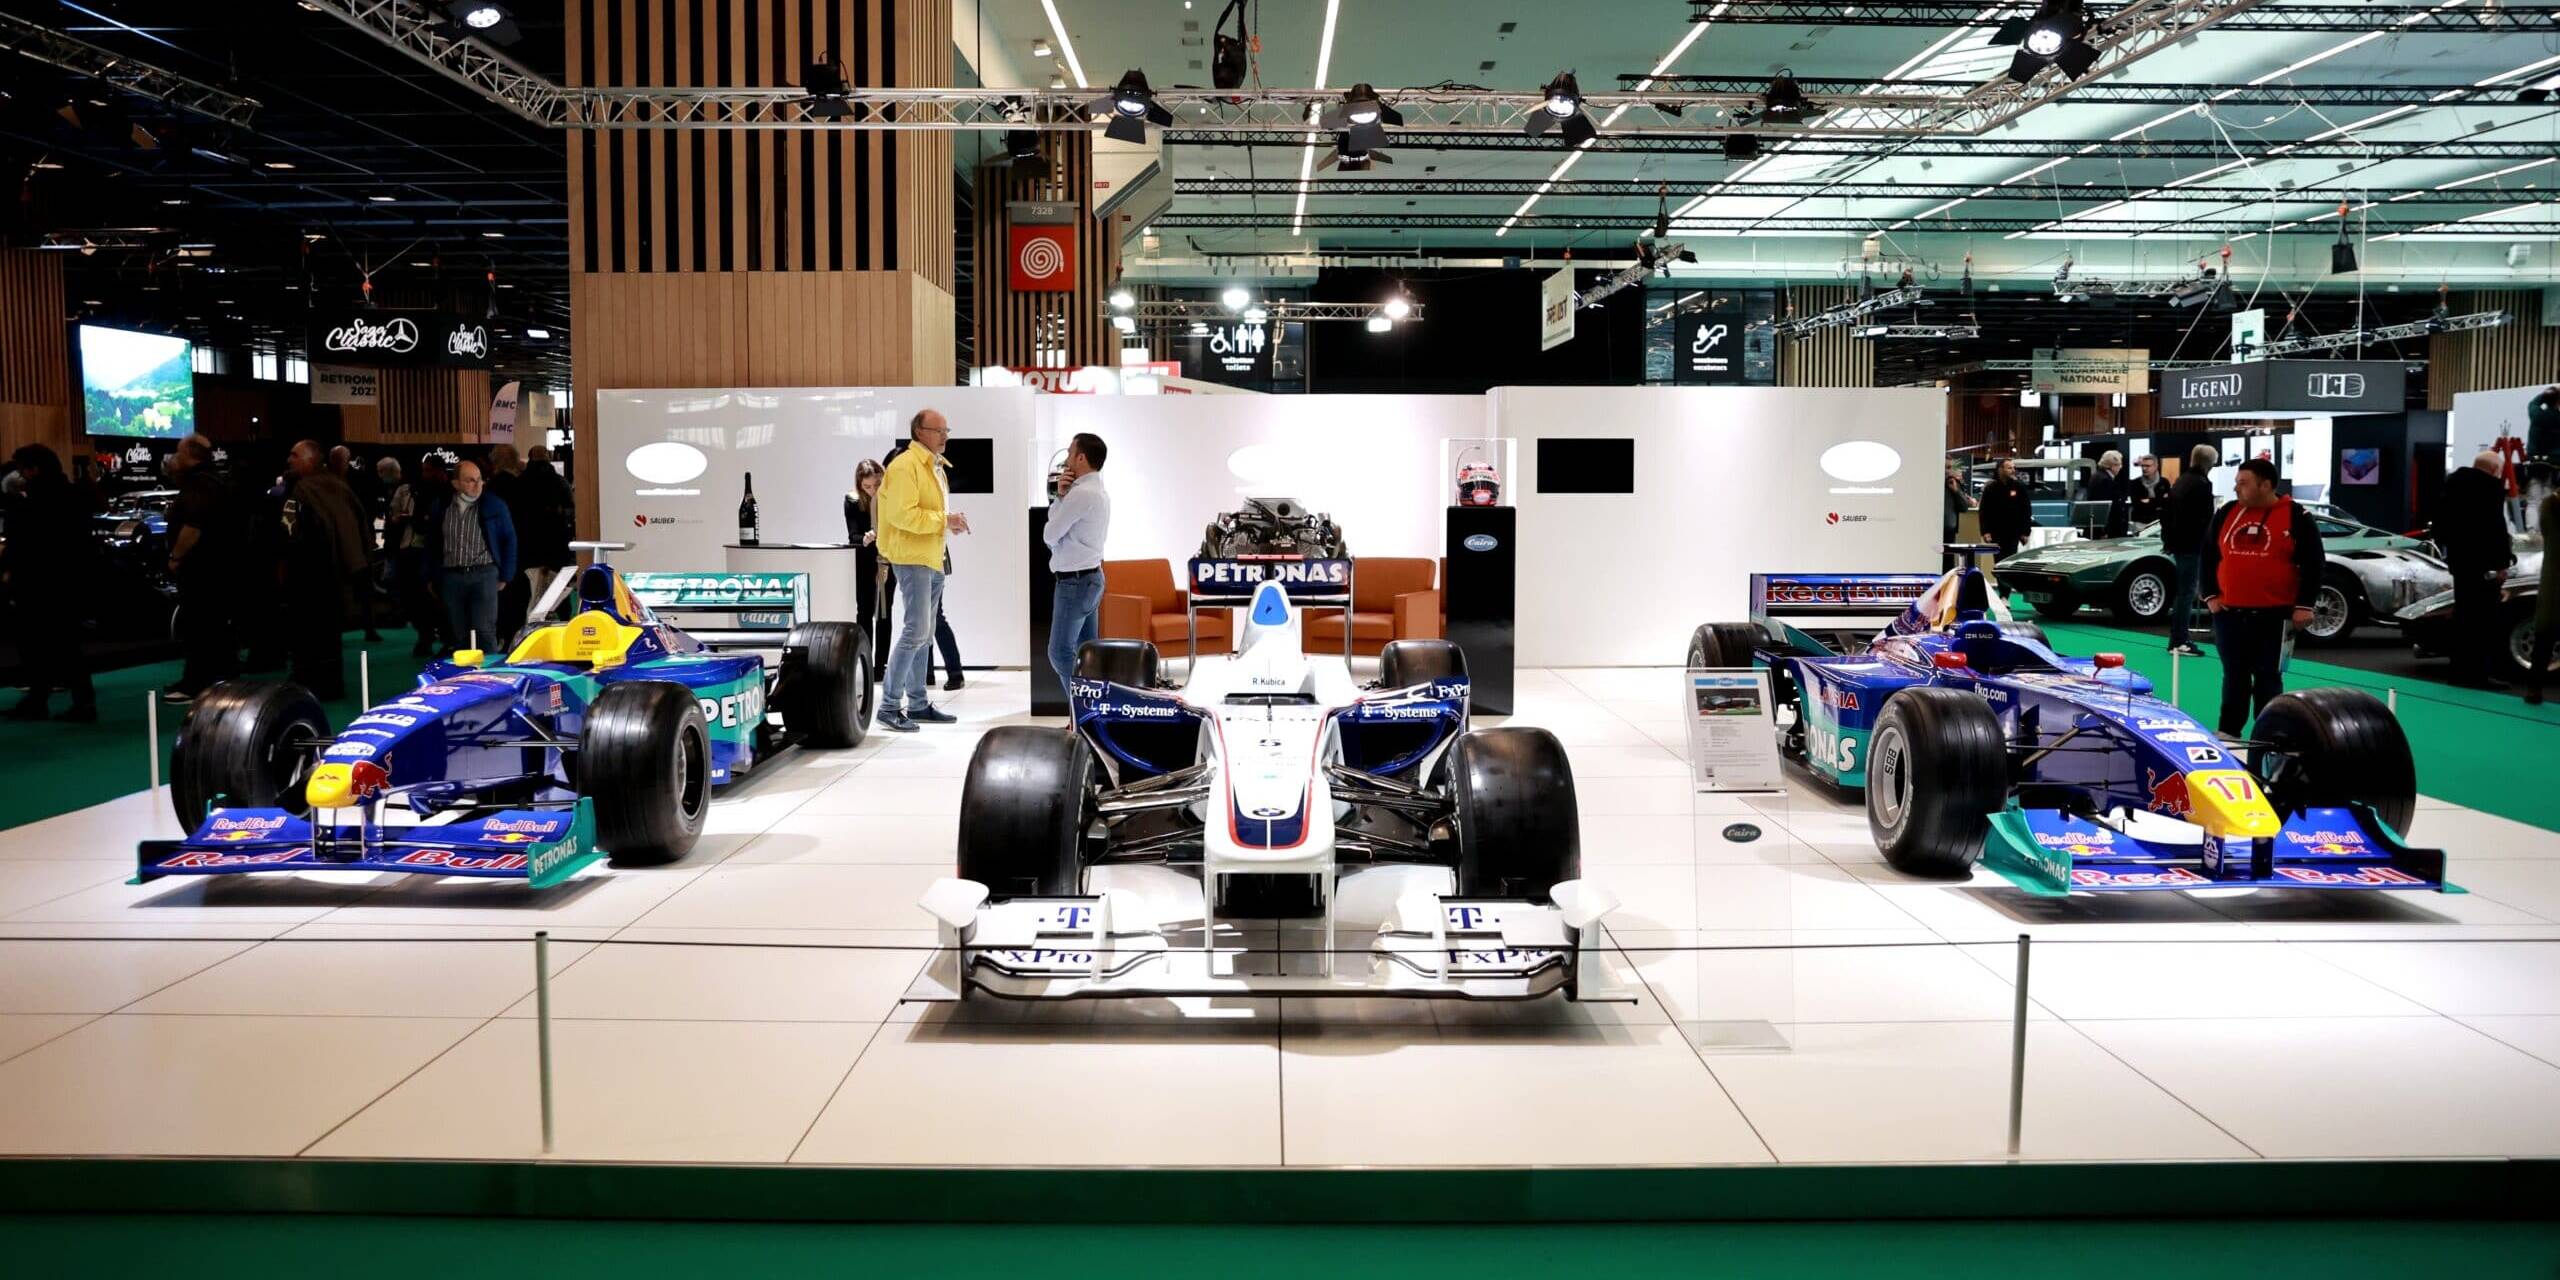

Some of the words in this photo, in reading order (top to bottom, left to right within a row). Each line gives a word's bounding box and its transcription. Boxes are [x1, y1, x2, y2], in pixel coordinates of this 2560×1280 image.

[325, 327, 396, 351] Classic
[2060, 375, 2121, 384] NATIONALE
[2182, 373, 2242, 400] LEGEND
[495, 400, 516, 410] RMC
[491, 422, 513, 433] RMC
[650, 517, 676, 525] SAUBER
[1198, 562, 1344, 583] PETRONAS
[699, 685, 764, 727] PETRO
[2207, 777, 2253, 800] 17
[160, 847, 312, 868] Red
[396, 849, 529, 870] Bull
[534, 835, 578, 877] PETRONAS
[2072, 868, 2206, 887] Red
[2273, 867, 2428, 885] Bull
[984, 949, 1093, 963] xPro
